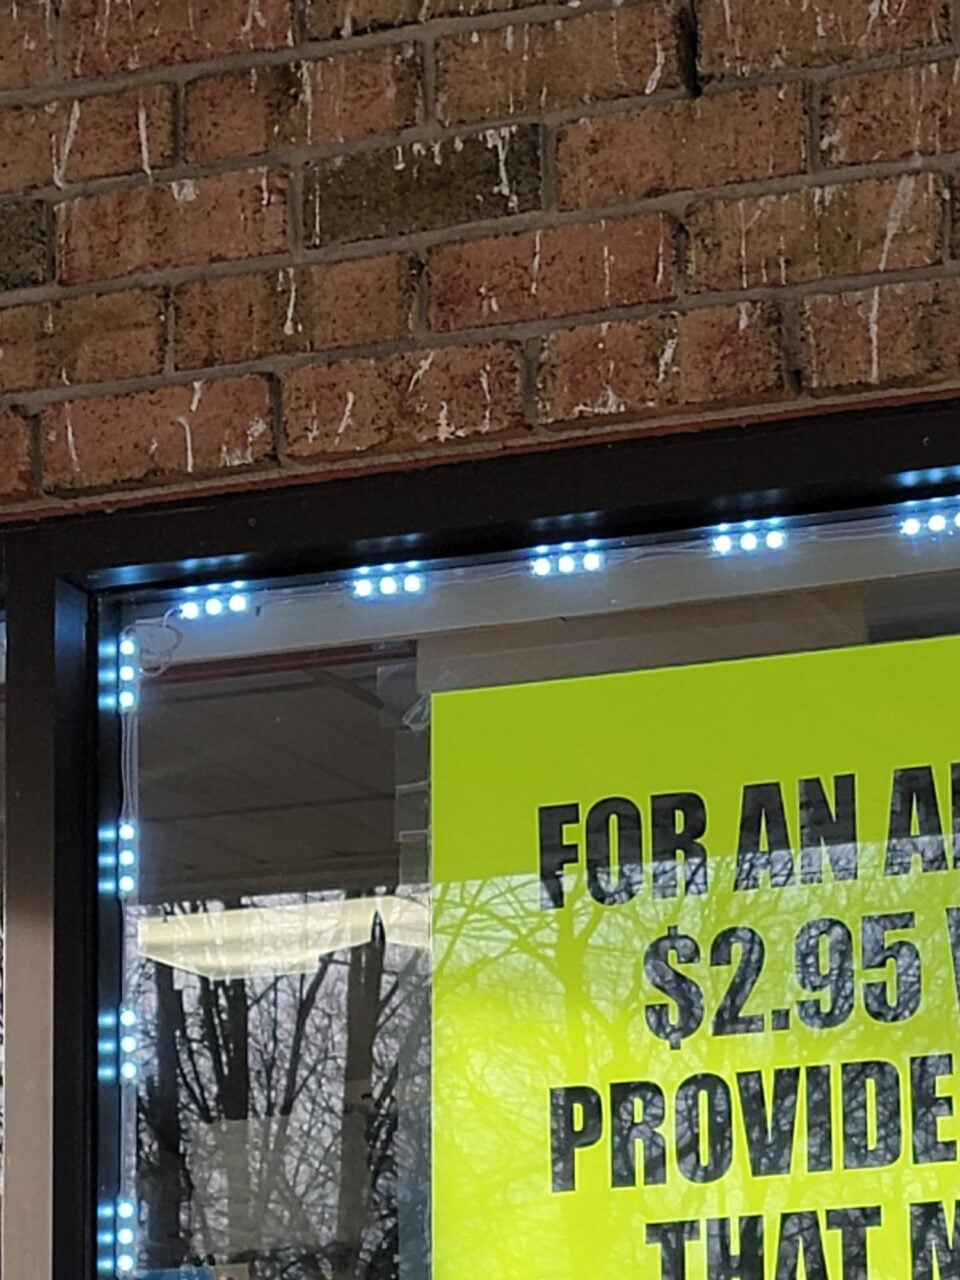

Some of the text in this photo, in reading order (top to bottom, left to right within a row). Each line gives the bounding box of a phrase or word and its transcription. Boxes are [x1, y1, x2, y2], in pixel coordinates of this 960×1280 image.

[536, 791, 712, 910] FOR
[732, 774, 862, 894] AN
[643, 914, 922, 1050] $2.95
[550, 1054, 956, 1192] PROVIDE
